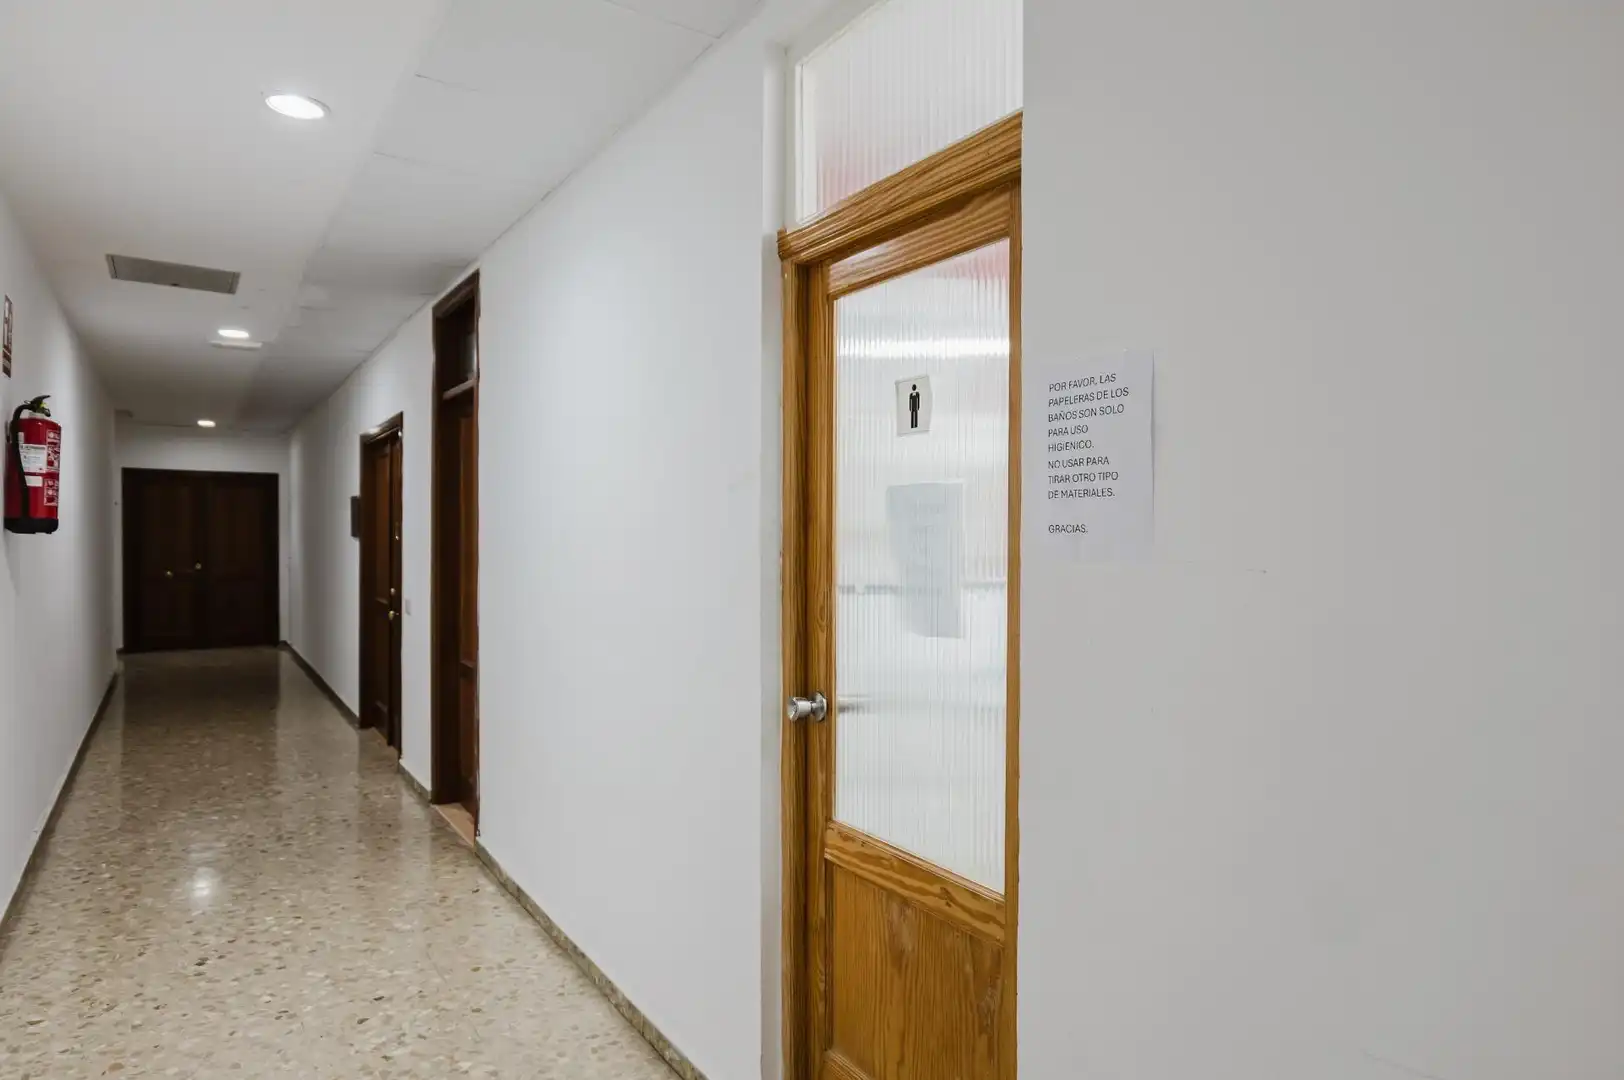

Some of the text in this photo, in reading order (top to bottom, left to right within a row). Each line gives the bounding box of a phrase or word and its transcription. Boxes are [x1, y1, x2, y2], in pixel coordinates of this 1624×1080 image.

[1049, 381, 1066, 393] POR
[1099, 373, 1117, 384] LAS
[1048, 387, 1129, 407] PAPELERAS DE LOS
[1048, 403, 1125, 422] BAÑOS SON SOLO
[1048, 424, 1089, 437] PARA USO
[1048, 456, 1110, 469] NO USAR PARA
[1048, 471, 1119, 484] TIRAR OTRO TIPO
[1048, 487, 1116, 500] DE MATERIALES.
[1048, 523, 1088, 534] GRACIAS.
